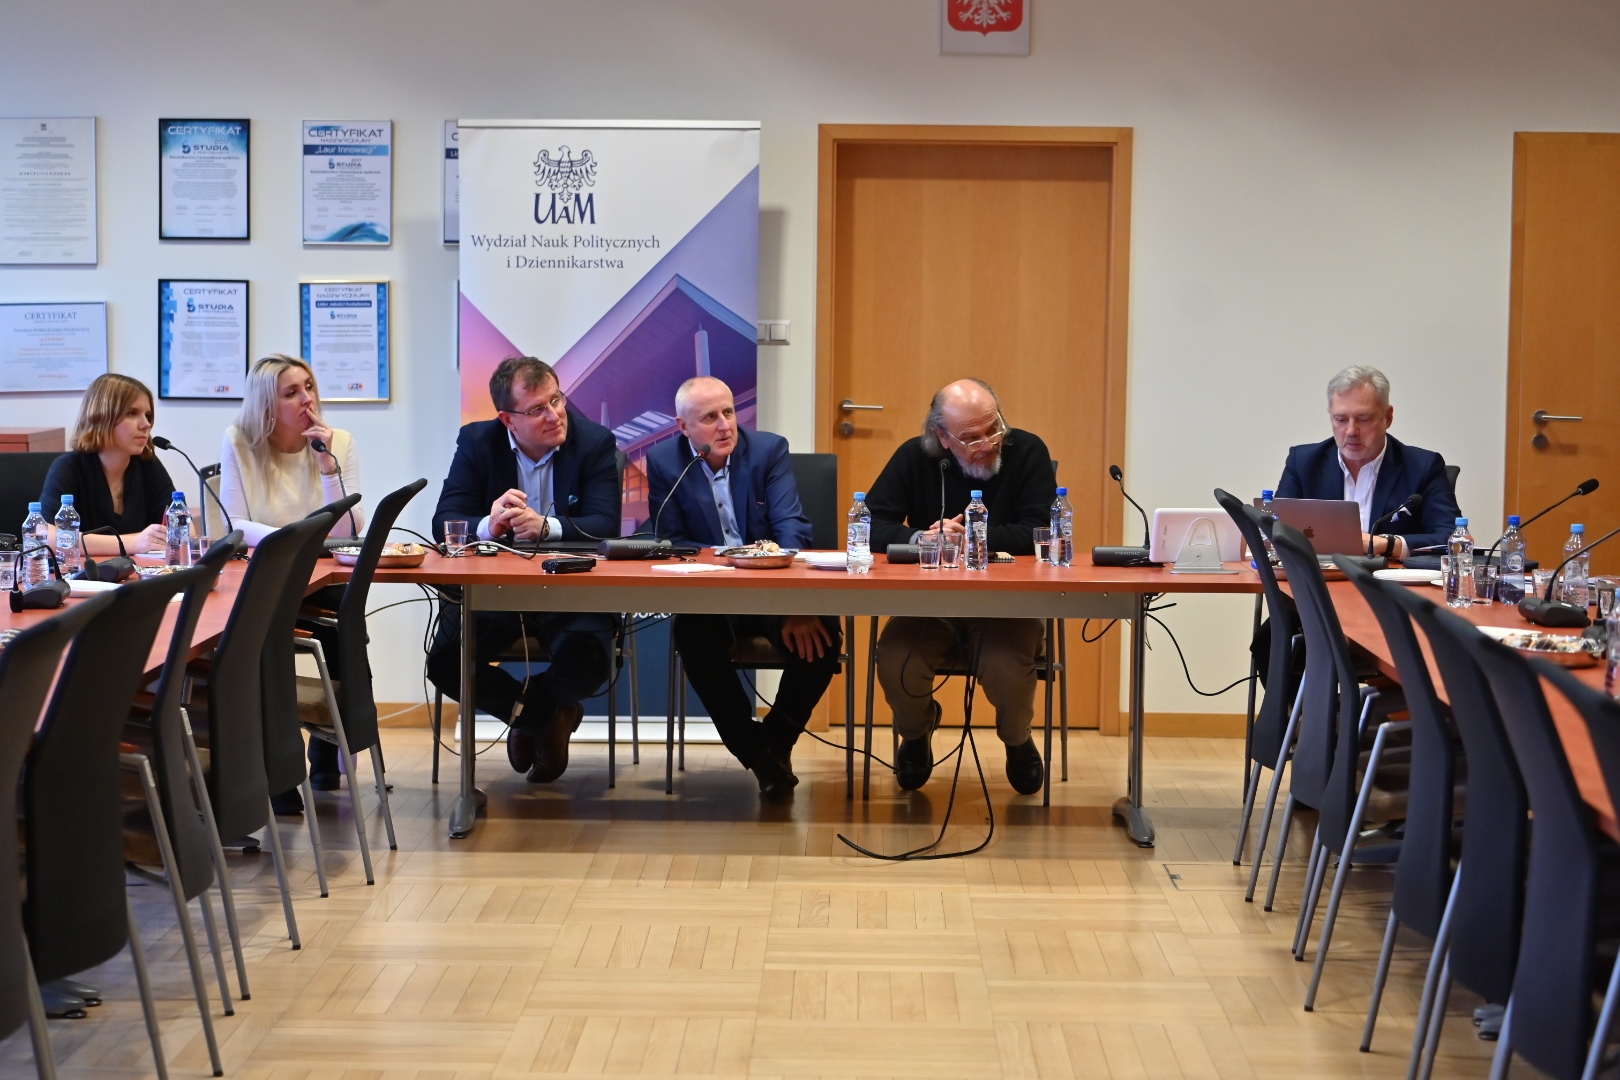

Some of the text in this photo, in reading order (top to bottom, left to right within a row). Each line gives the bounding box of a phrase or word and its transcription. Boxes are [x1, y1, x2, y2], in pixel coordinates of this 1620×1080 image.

[167, 126, 242, 135] CERTYFIKAT
[308, 129, 384, 138] CERTYFIKAT
[534, 193, 596, 224] UAM
[471, 234, 660, 252] Wydział Nauk Politycznych
[506, 256, 624, 270] i Dziennikarstwa
[24, 312, 78, 320] CERTYFIKAT
